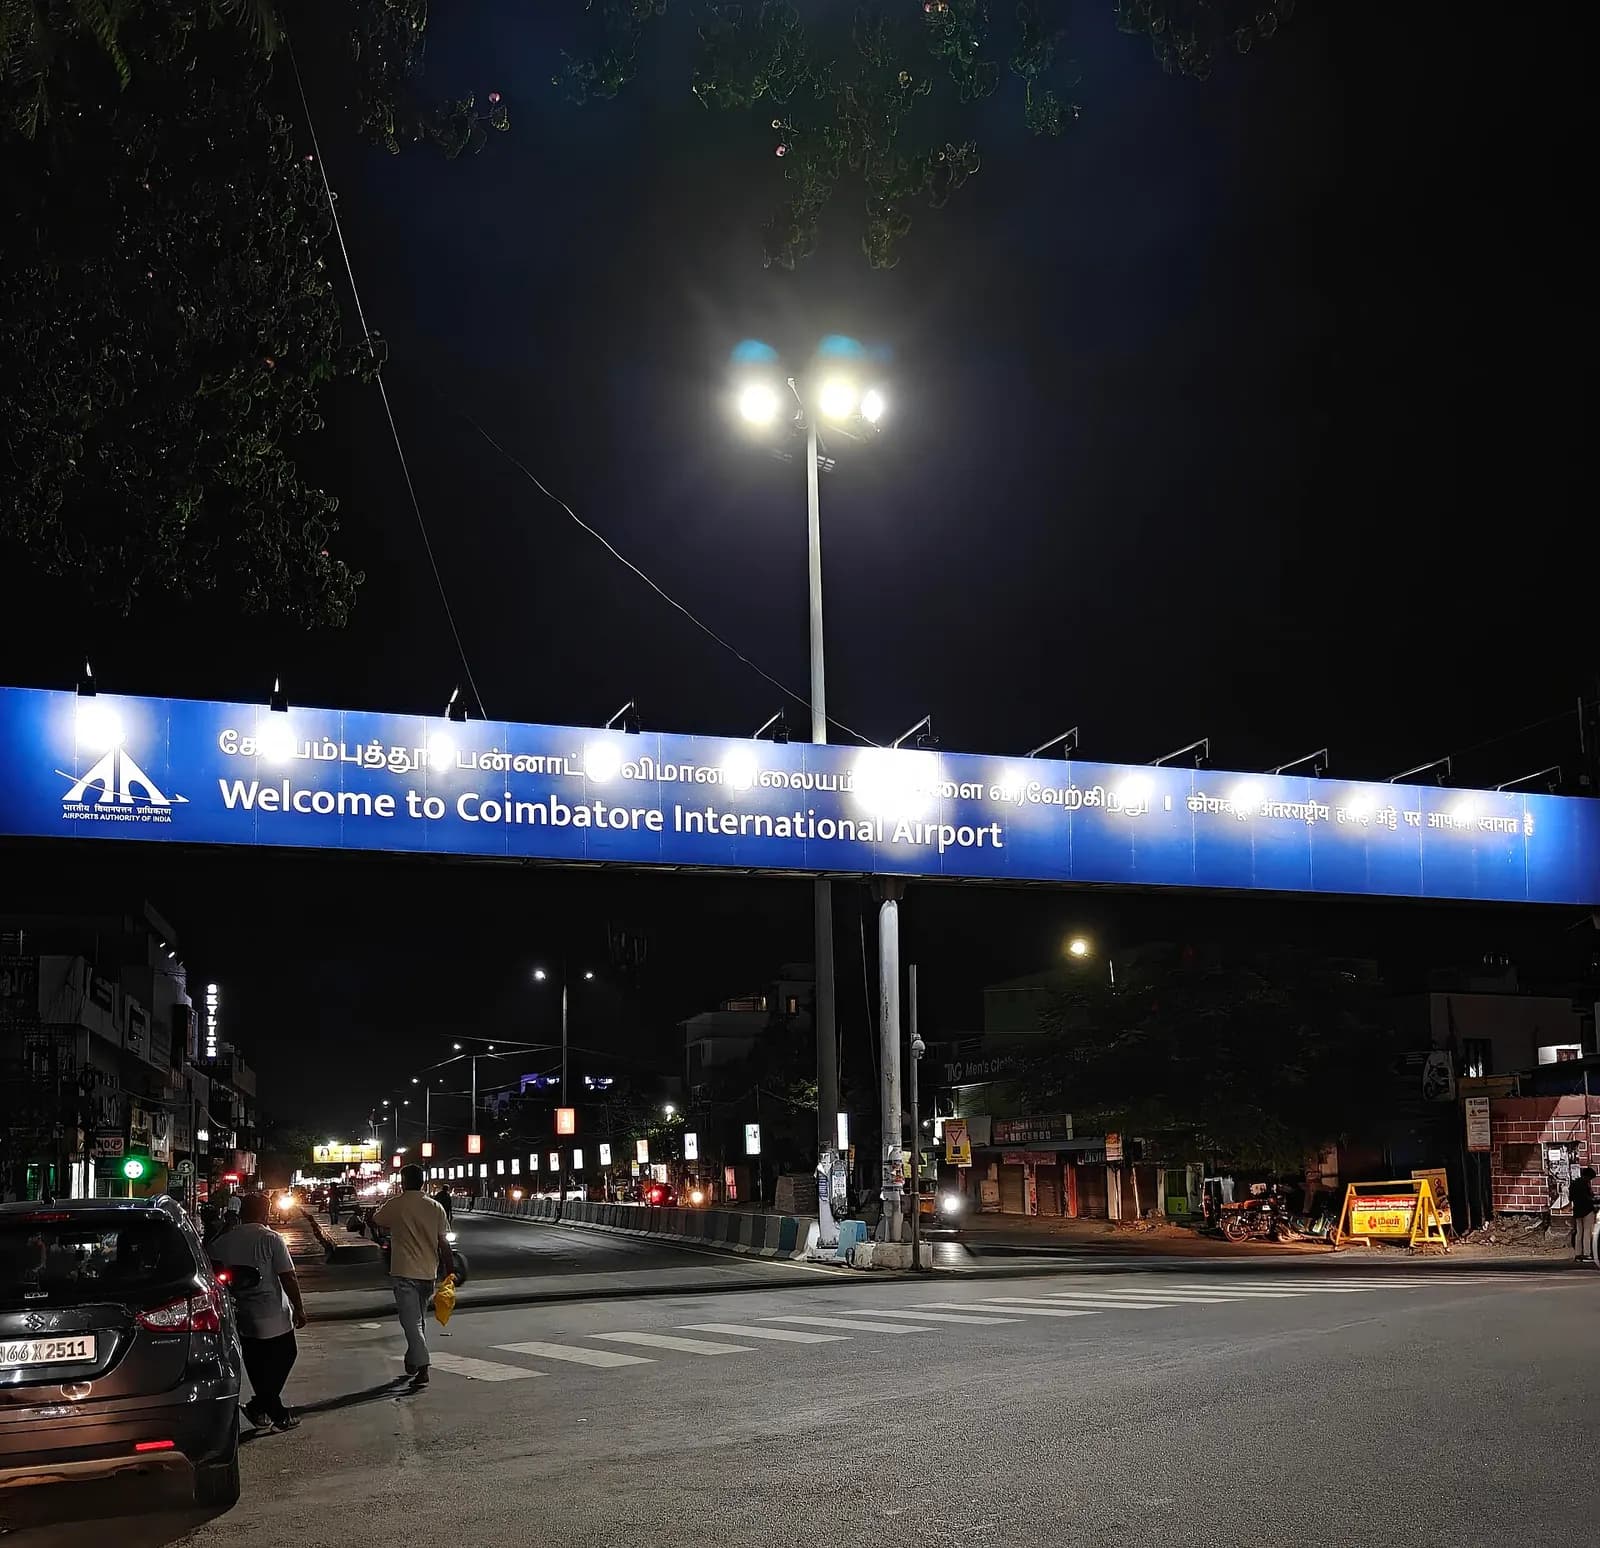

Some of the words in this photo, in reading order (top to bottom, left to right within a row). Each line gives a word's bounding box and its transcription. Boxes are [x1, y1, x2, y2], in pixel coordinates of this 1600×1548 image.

[62, 812, 98, 821] AIRPORTS
[100, 813, 140, 822] AUTHORITY
[141, 814, 152, 823] OF
[153, 814, 172, 824] INDIA
[218, 778, 396, 817] Welcome
[405, 789, 446, 819] to
[456, 792, 664, 832] Coimbatore
[674, 804, 884, 843] International
[891, 816, 1004, 853] Airport
[46, 1341, 87, 1360] 2511
